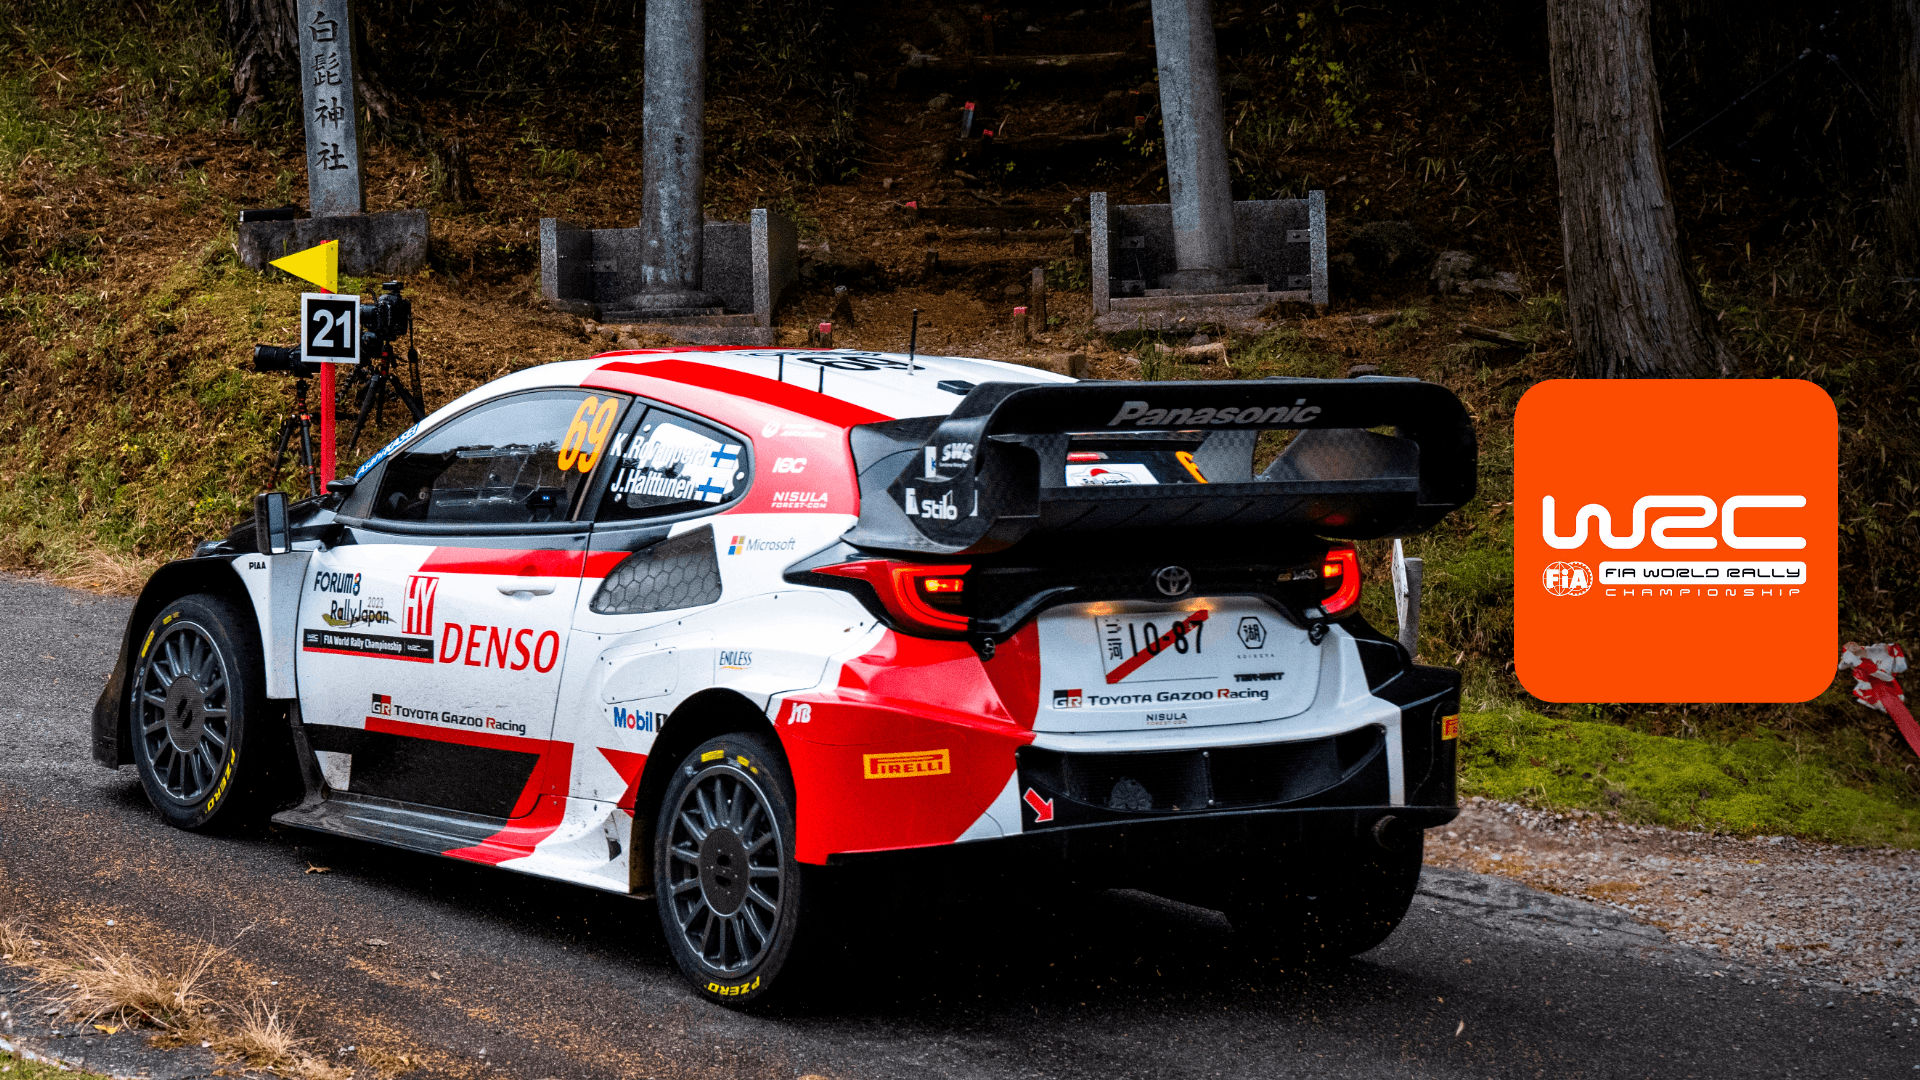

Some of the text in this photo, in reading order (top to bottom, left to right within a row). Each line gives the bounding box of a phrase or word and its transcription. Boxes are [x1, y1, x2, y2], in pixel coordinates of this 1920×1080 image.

[309, 11, 348, 171] 白髭神社
[312, 308, 351, 348] 21
[1107, 398, 1322, 426] Panasonic
[558, 396, 619, 473] 69
[773, 491, 828, 502] NISULA
[746, 537, 796, 551] Microsoft
[249, 561, 267, 570] PIAA
[314, 571, 361, 596] FORUM8
[367, 597, 384, 608] 2023
[364, 639, 402, 653] Championship
[439, 622, 560, 673] DENSO
[1129, 621, 1204, 657] 10-87
[719, 650, 752, 666] ENDLESS
[1087, 694, 1152, 706] TOYOTA
[1156, 691, 1213, 702] GAZOO
[1217, 687, 1269, 700] Racing
[394, 704, 438, 721] TOYOTA
[441, 711, 483, 728] GAZOO
[485, 717, 527, 736] Racing
[614, 707, 653, 732] Mobil
[1146, 712, 1188, 721] NISULA
[869, 753, 944, 775] PIRELLI
